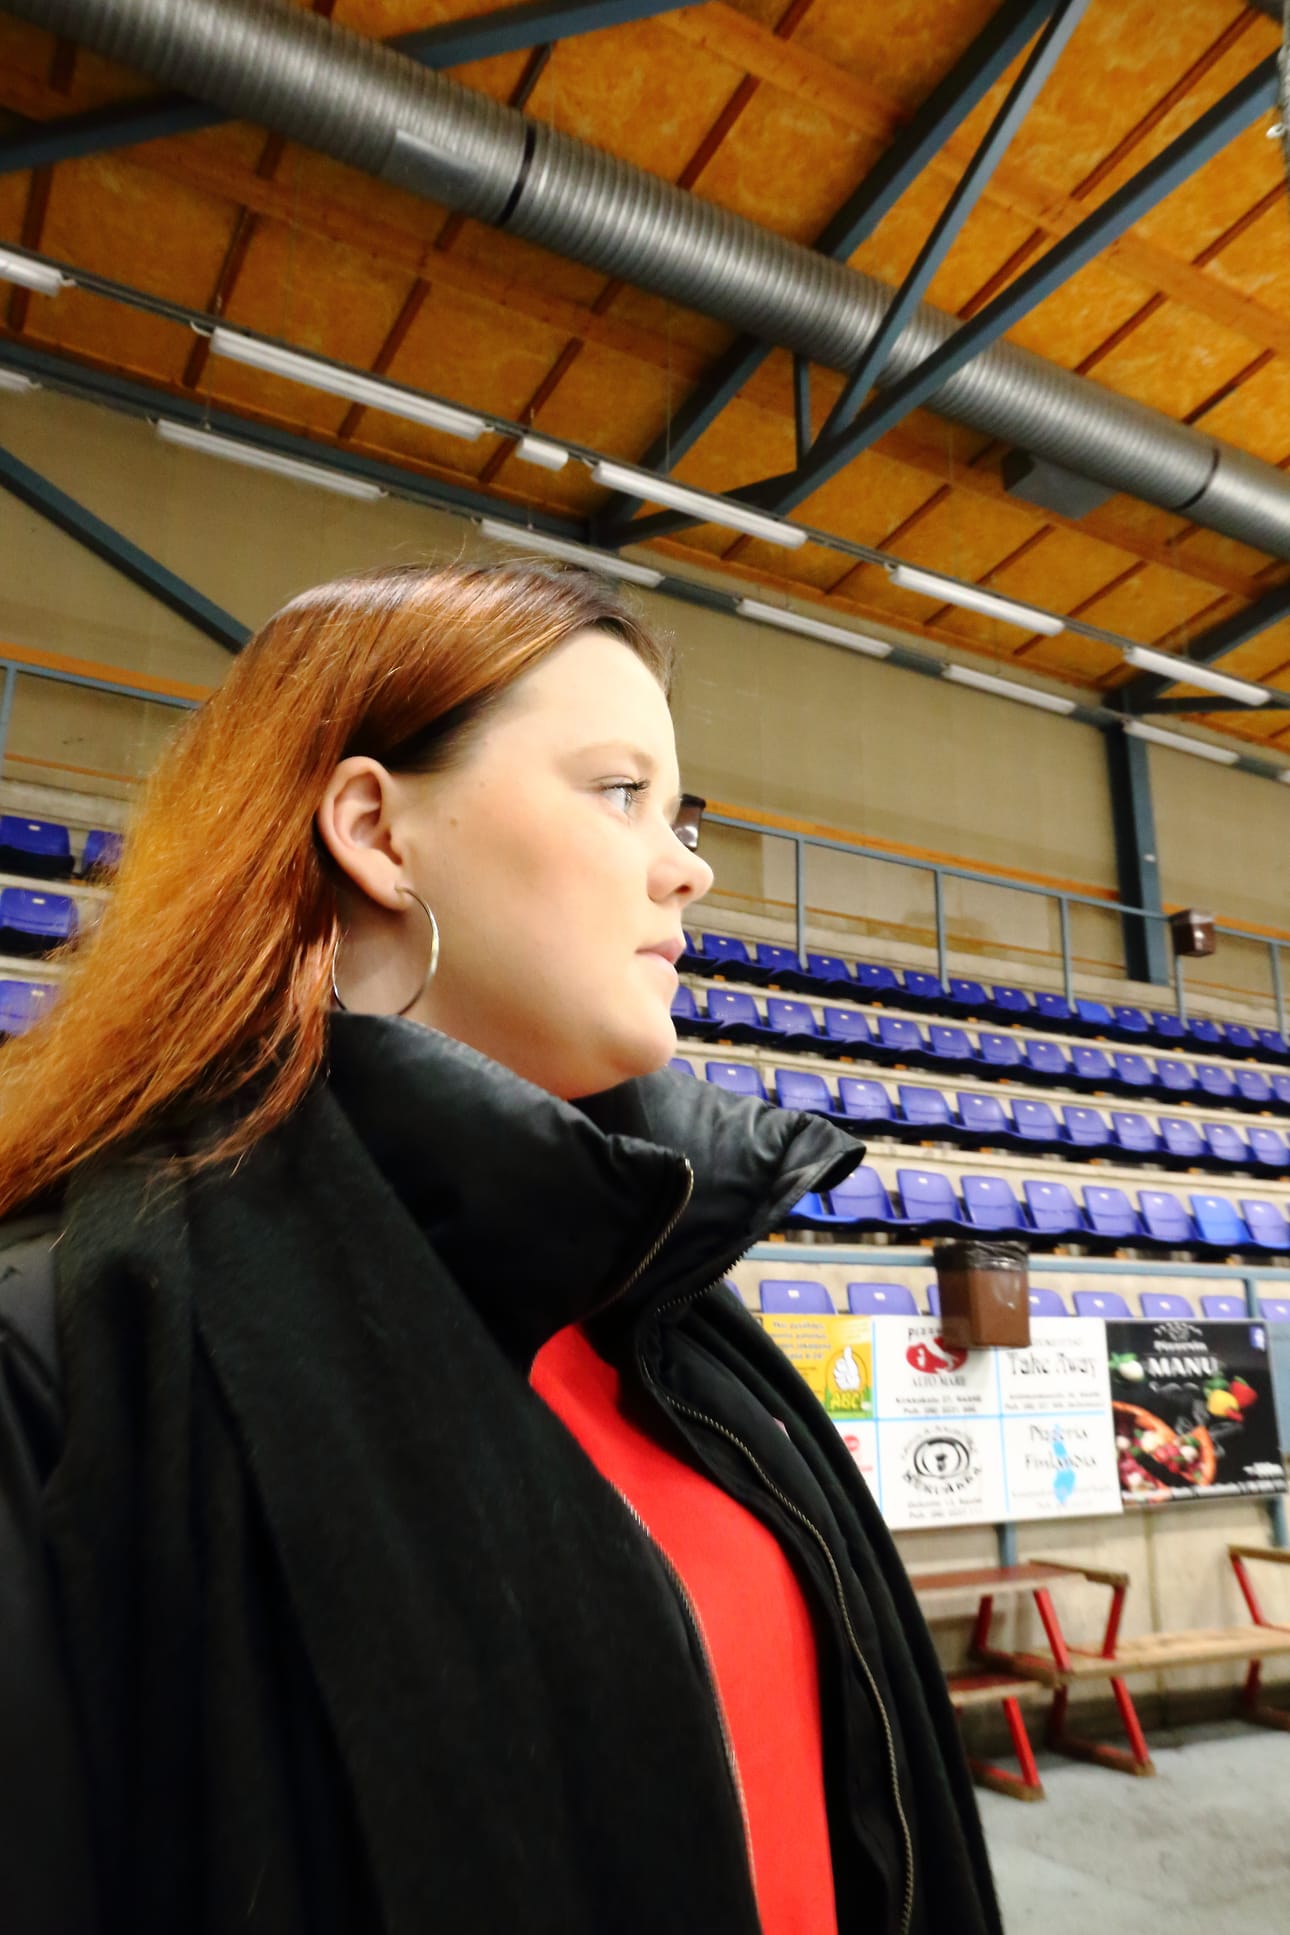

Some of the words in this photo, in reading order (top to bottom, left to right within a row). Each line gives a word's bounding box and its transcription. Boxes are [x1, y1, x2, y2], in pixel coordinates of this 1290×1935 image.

[1005, 1352, 1050, 1376] Take
[1055, 1352, 1097, 1379] Away
[1148, 1357, 1219, 1376] MANU
